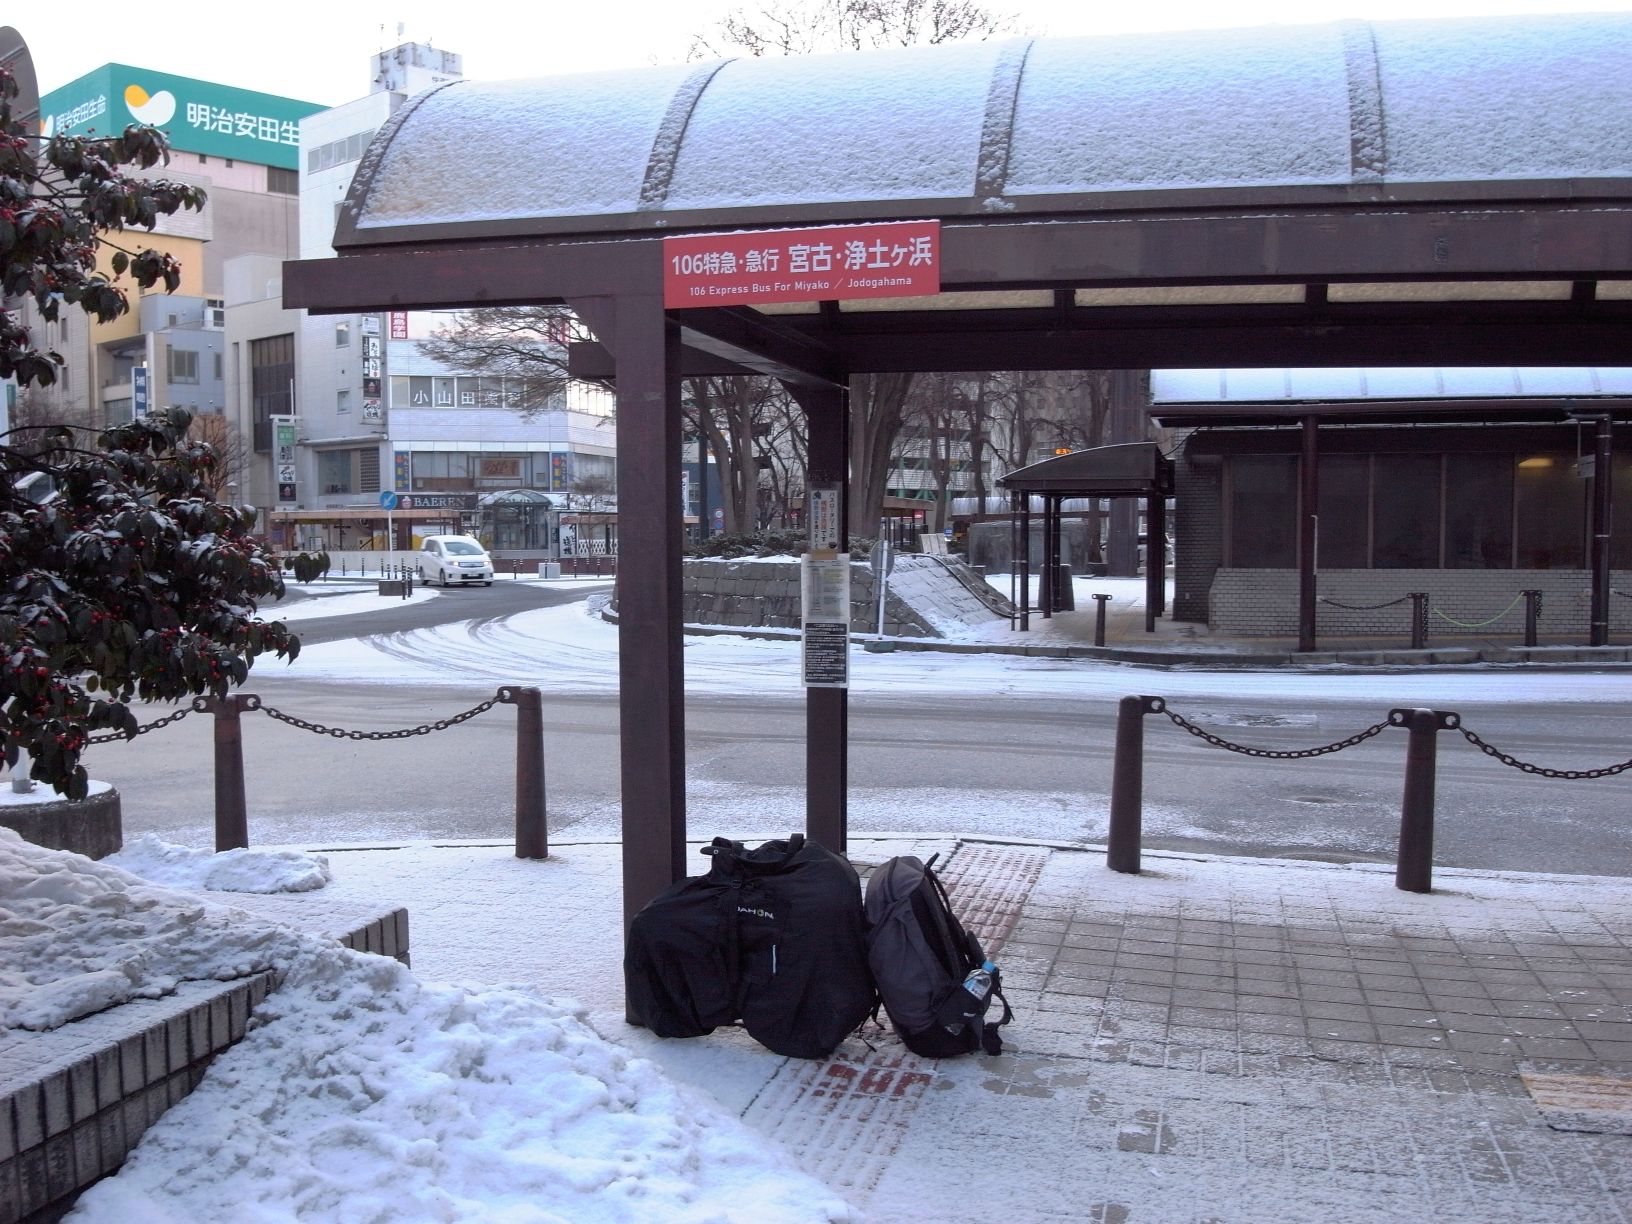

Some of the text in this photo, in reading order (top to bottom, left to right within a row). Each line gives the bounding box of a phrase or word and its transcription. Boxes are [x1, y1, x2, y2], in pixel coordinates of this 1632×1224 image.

[55, 94, 106, 133] 明治安田生命
[187, 102, 299, 147] 明治安田生
[690, 286, 706, 296] 106
[709, 284, 749, 297] Express
[752, 283, 771, 293] Bus
[775, 282, 790, 291] For
[795, 280, 829, 293] Miyako
[848, 276, 912, 289] Jodogahama
[414, 497, 466, 507] BAEREN
